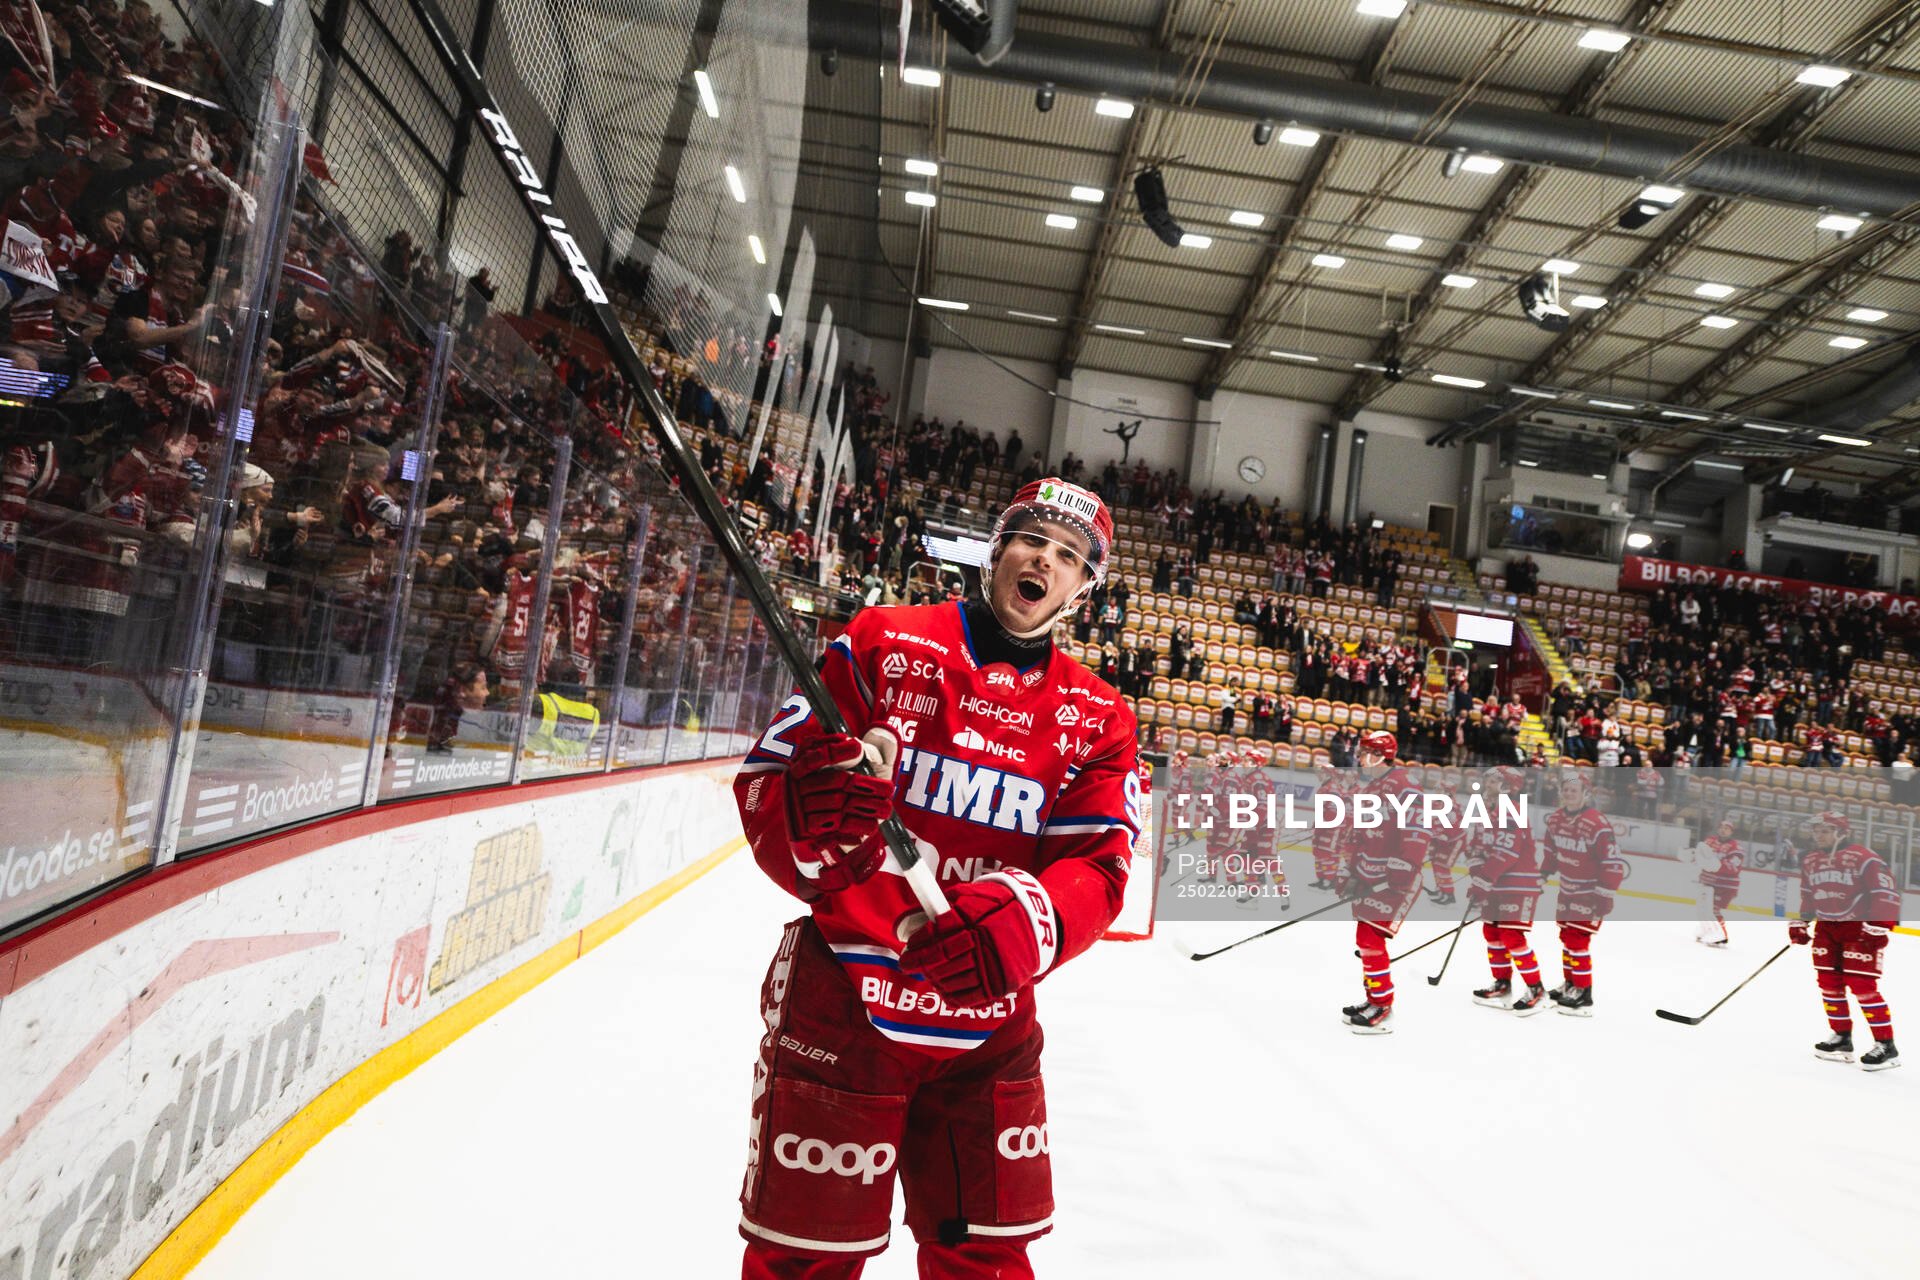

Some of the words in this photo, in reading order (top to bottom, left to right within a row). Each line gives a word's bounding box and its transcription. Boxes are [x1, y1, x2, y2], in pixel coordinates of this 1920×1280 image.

[1057, 490, 1096, 518] LILIUM
[911, 660, 944, 684] SCA
[986, 672, 1015, 690] SHL
[897, 690, 938, 716] LILIUM
[959, 694, 1034, 729] HIGHCON
[760, 693, 813, 758] 2
[986, 740, 1026, 763] NHC
[416, 756, 492, 784] brandcode.se
[242, 770, 334, 823] Brandcode
[773, 1132, 897, 1185] coop
